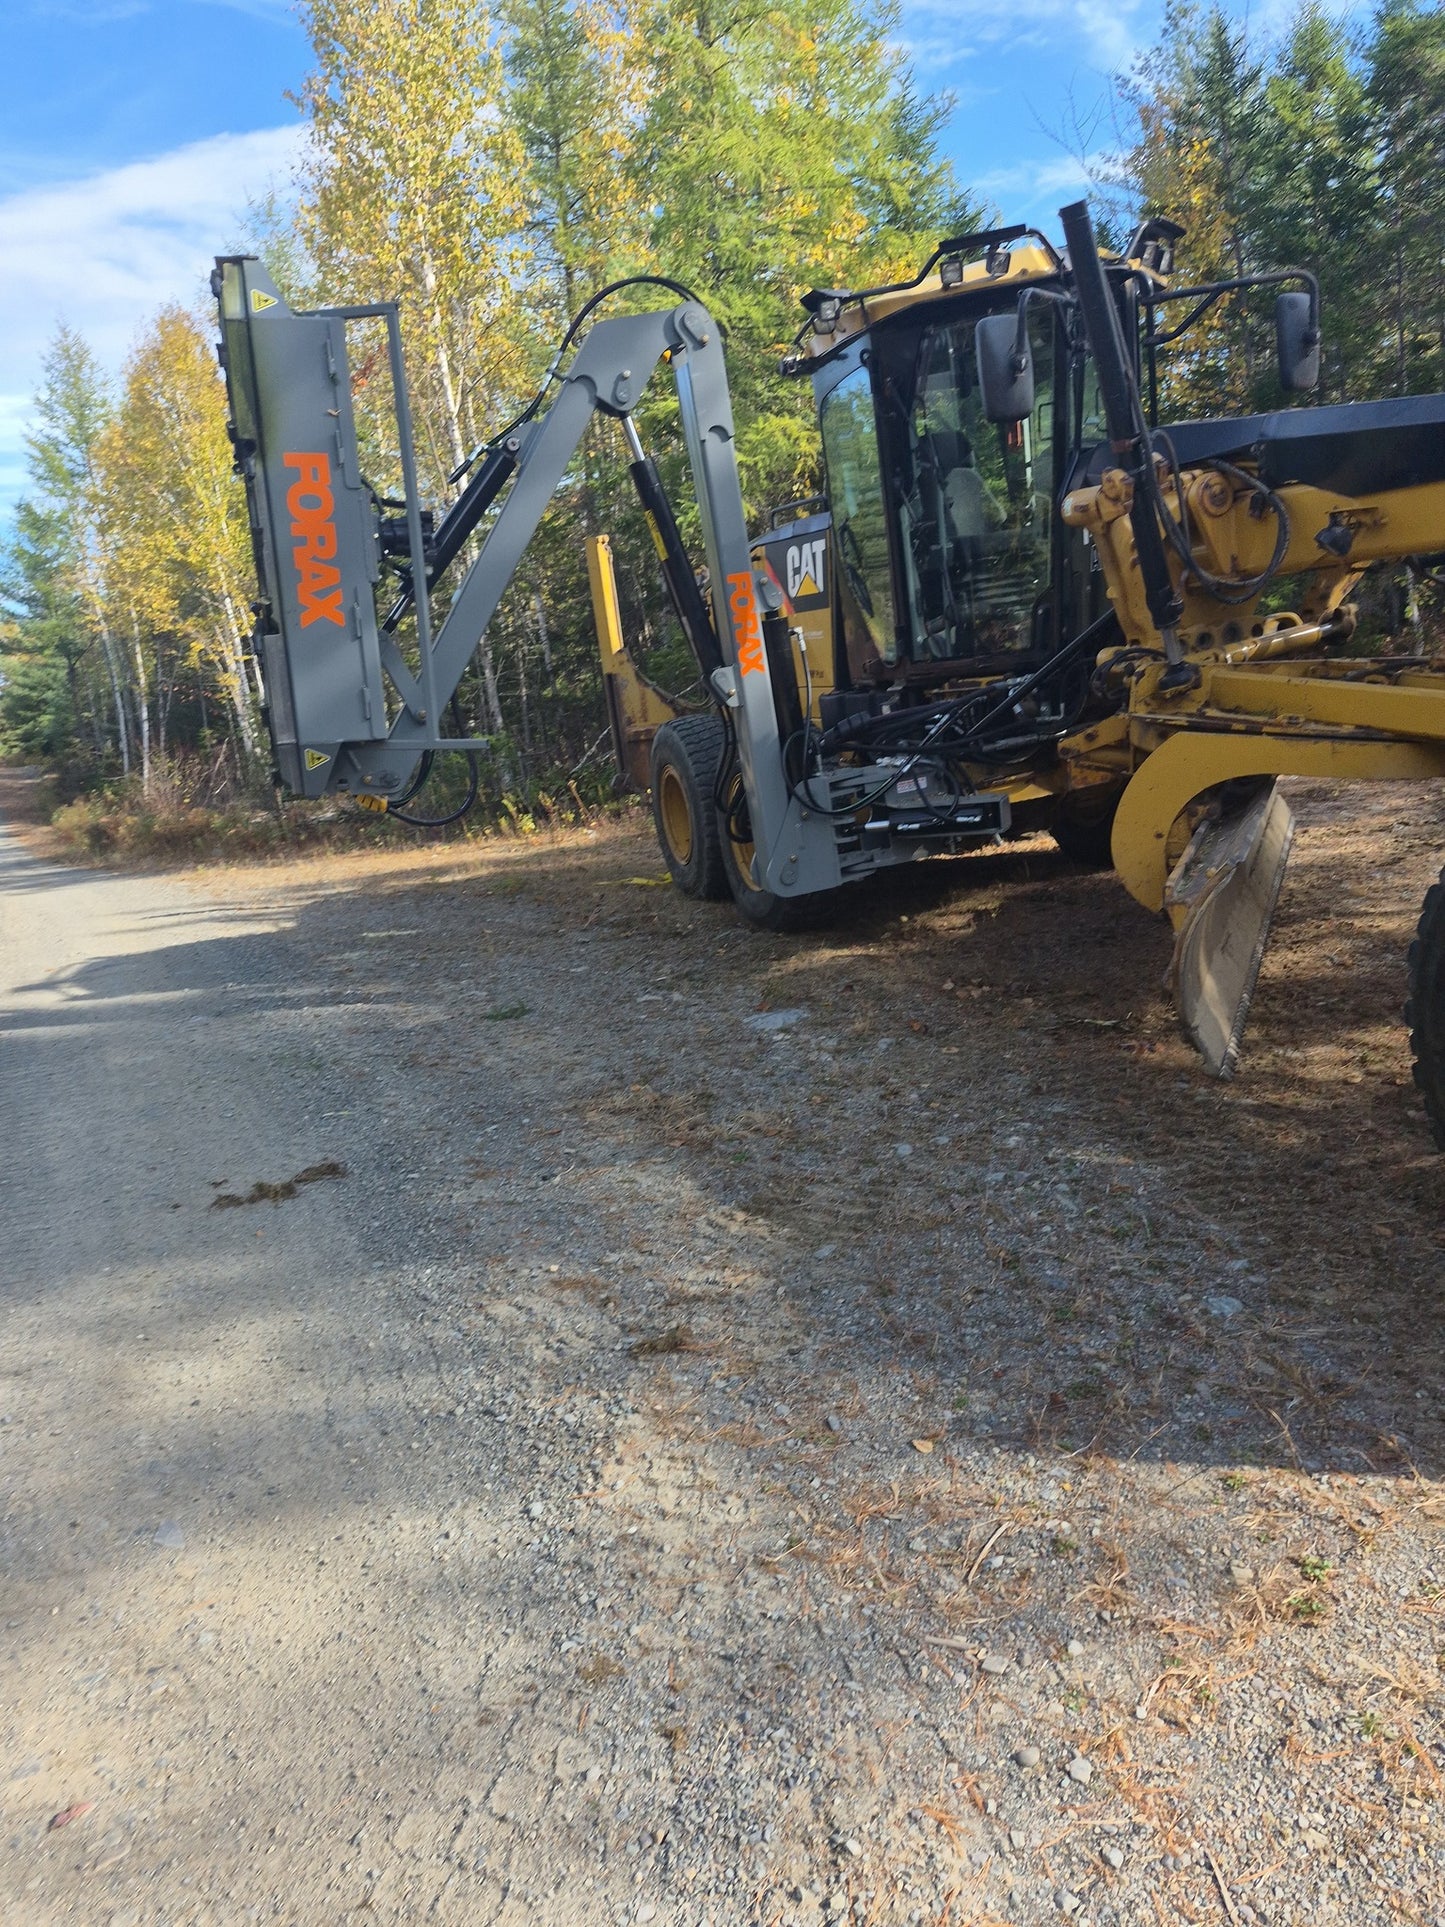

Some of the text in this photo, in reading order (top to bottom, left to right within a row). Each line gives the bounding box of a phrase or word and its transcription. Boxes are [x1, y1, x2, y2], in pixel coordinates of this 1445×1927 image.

[283, 452, 346, 629] FORAX
[786, 538, 826, 599] CAT
[726, 571, 766, 678] FORAX
